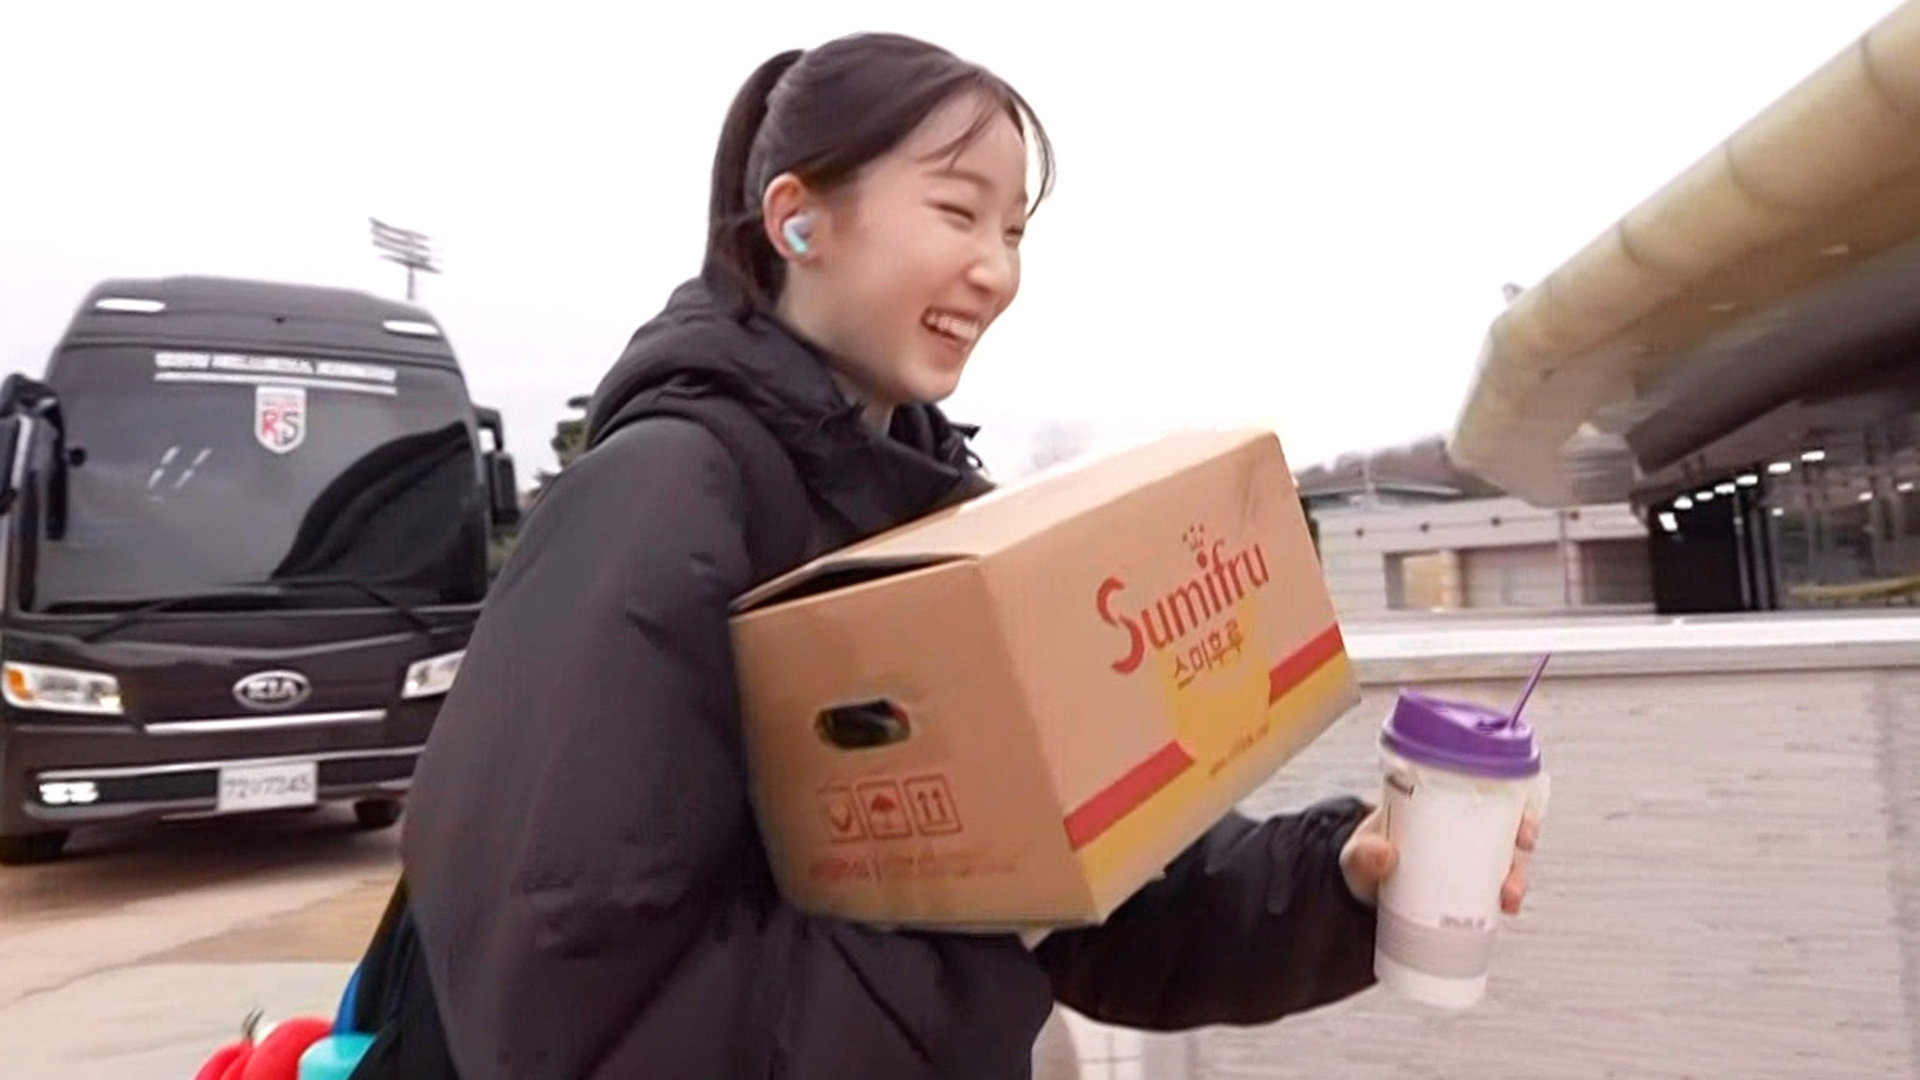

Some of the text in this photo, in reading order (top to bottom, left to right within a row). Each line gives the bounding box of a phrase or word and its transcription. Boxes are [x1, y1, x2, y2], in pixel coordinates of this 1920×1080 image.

[1096, 539, 1269, 675] Sumifru
[246, 679, 298, 700] KIA
[1173, 619, 1244, 690] 스미후루
